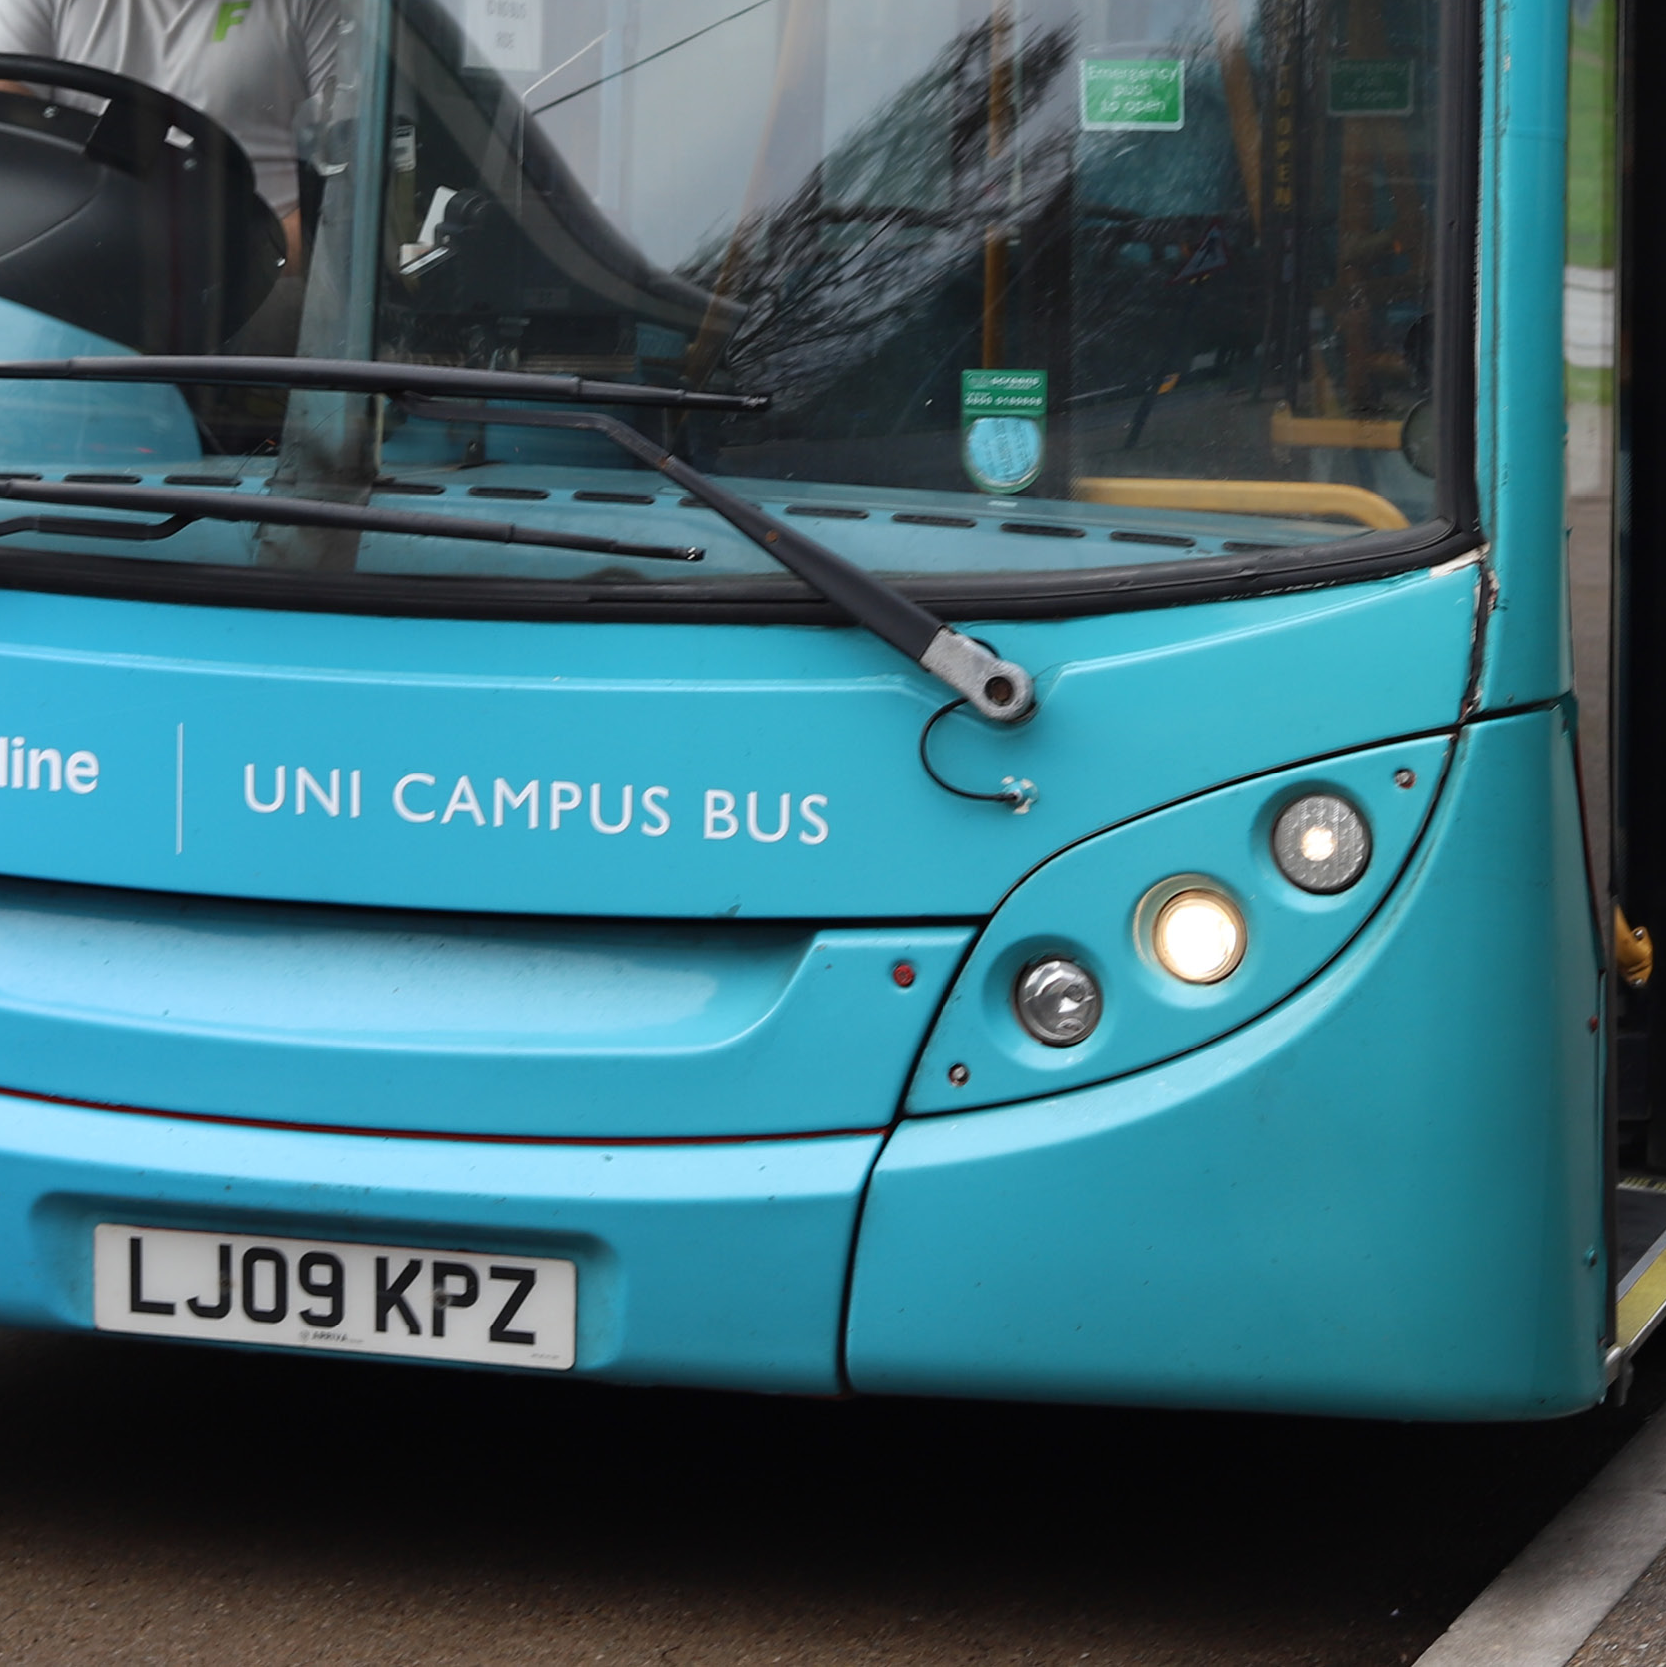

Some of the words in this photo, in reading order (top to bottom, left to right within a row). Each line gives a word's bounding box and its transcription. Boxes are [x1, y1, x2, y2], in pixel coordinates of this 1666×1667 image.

[242, 763, 362, 819] UNI
[391, 772, 673, 838] CAMPUS
[703, 788, 831, 847] BUS
[129, 1237, 346, 1328] LJ09
[375, 1256, 538, 1346] KPZ
